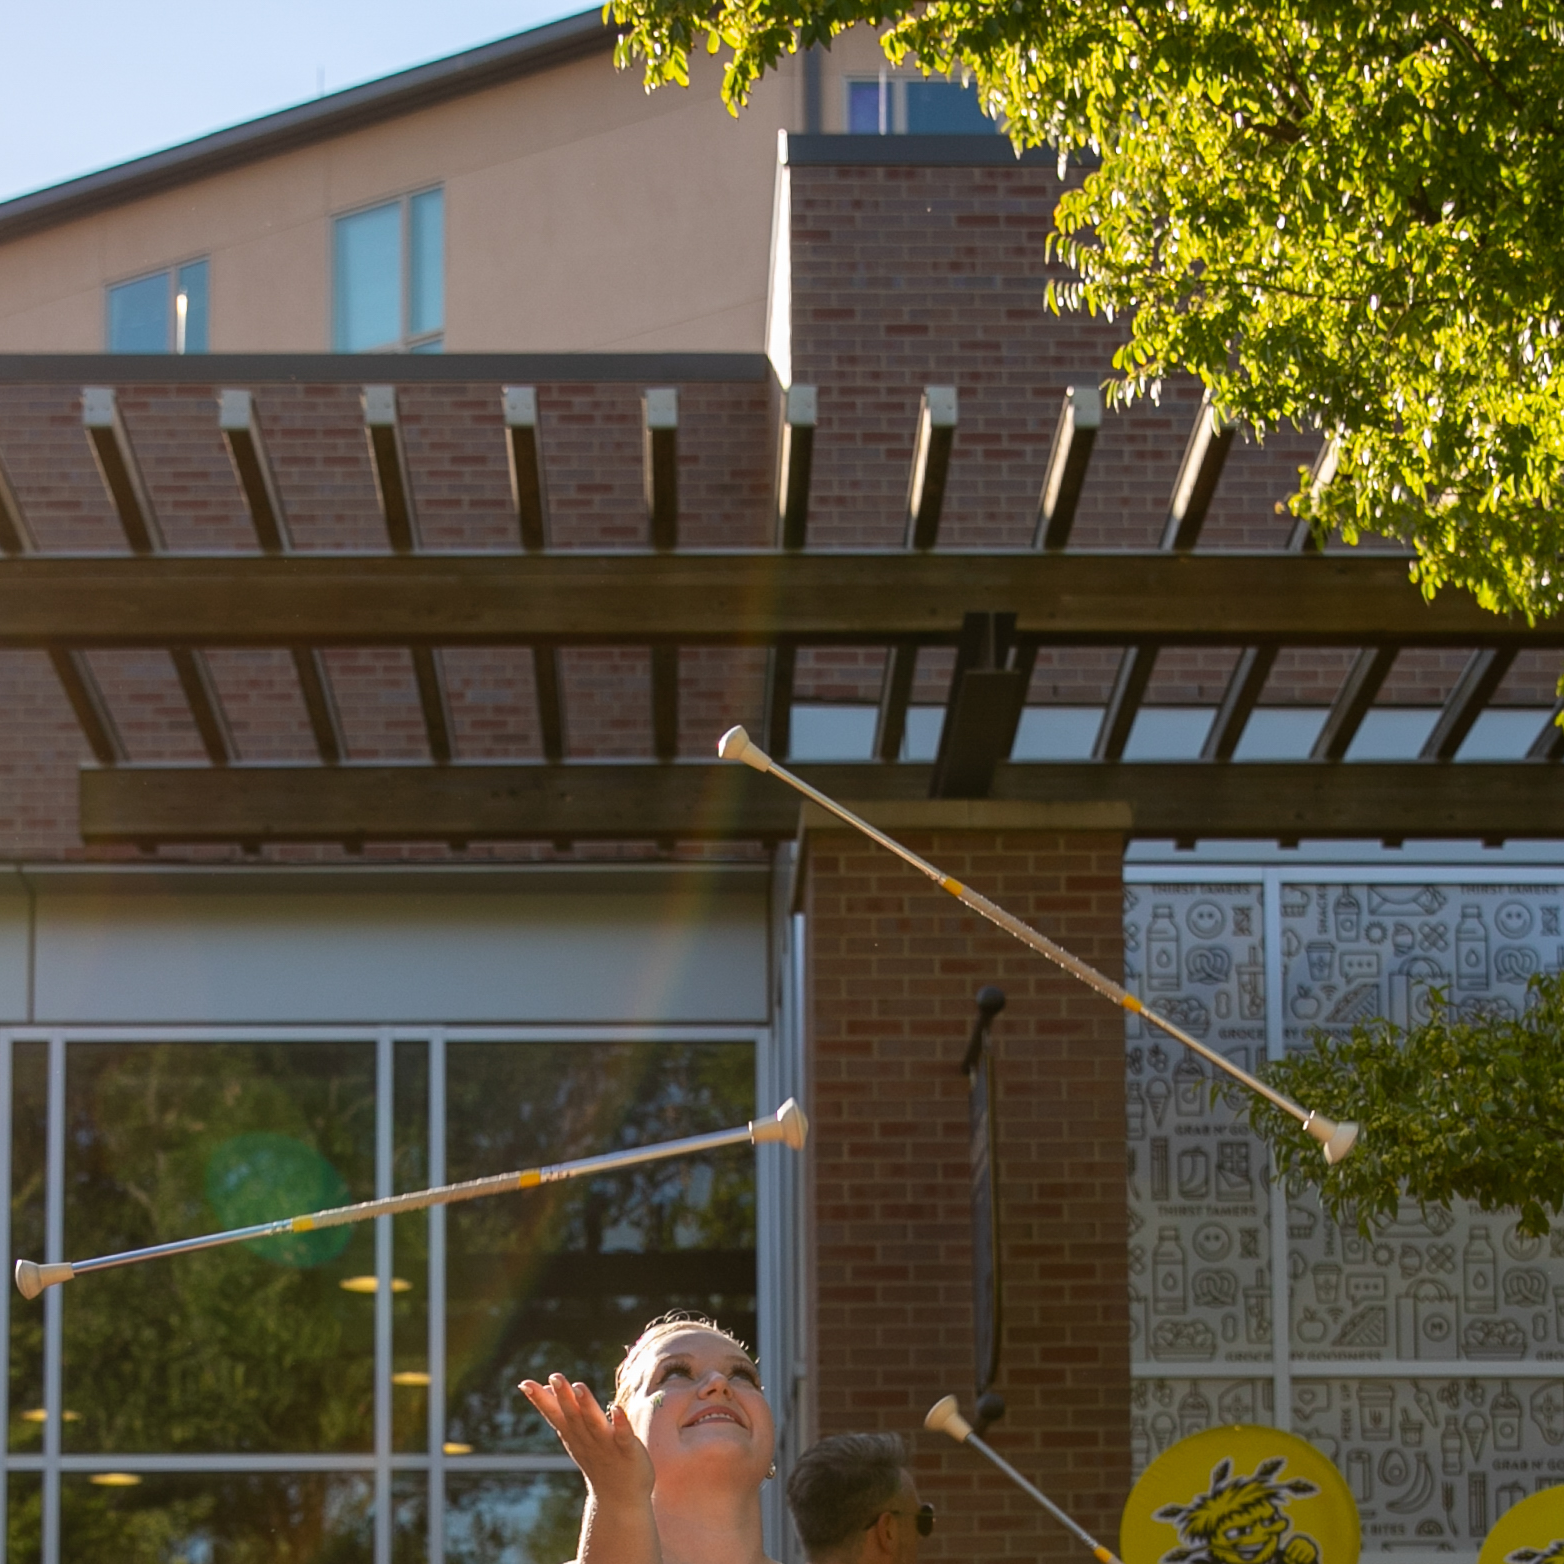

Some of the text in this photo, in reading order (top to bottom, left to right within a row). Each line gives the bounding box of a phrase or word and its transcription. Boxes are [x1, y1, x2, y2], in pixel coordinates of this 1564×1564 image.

[1151, 884, 1250, 894] THIRST TAMERS
[1461, 884, 1558, 895] THIRST TAMERS
[1174, 1124, 1210, 1136] GRAB
[1229, 1124, 1249, 1136] GO
[1157, 1204, 1257, 1217] THIRST TAMERS
[1307, 1350, 1382, 1362] GOODNESS
[1340, 1408, 1352, 1441] PERK
[1492, 1458, 1529, 1471] GRAB
[1370, 1524, 1406, 1536] BITES
